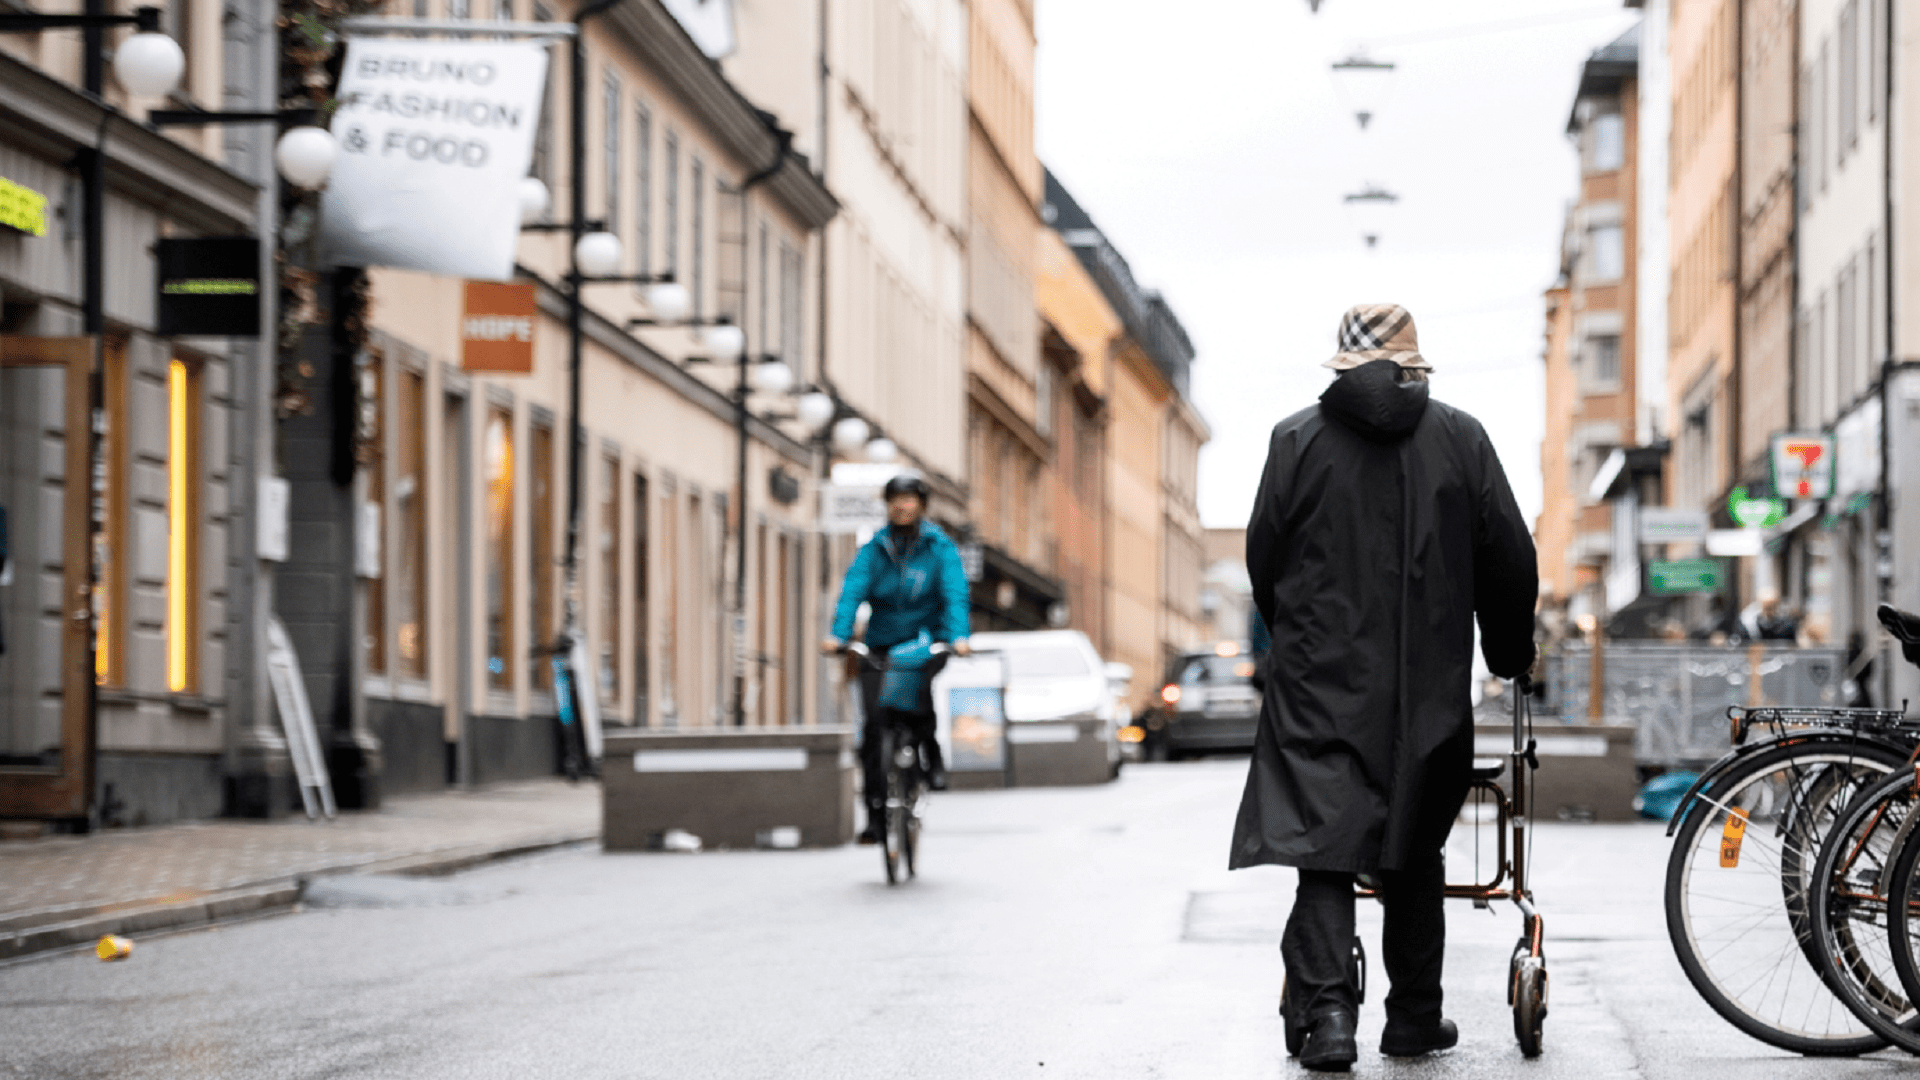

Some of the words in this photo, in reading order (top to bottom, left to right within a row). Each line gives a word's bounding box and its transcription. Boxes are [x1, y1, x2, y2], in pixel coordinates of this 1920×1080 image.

[357, 56, 497, 86] BRUNO
[345, 89, 523, 128] FASHION
[342, 125, 368, 154] &
[381, 127, 489, 168] FOOD
[463, 318, 533, 341] HOPE
